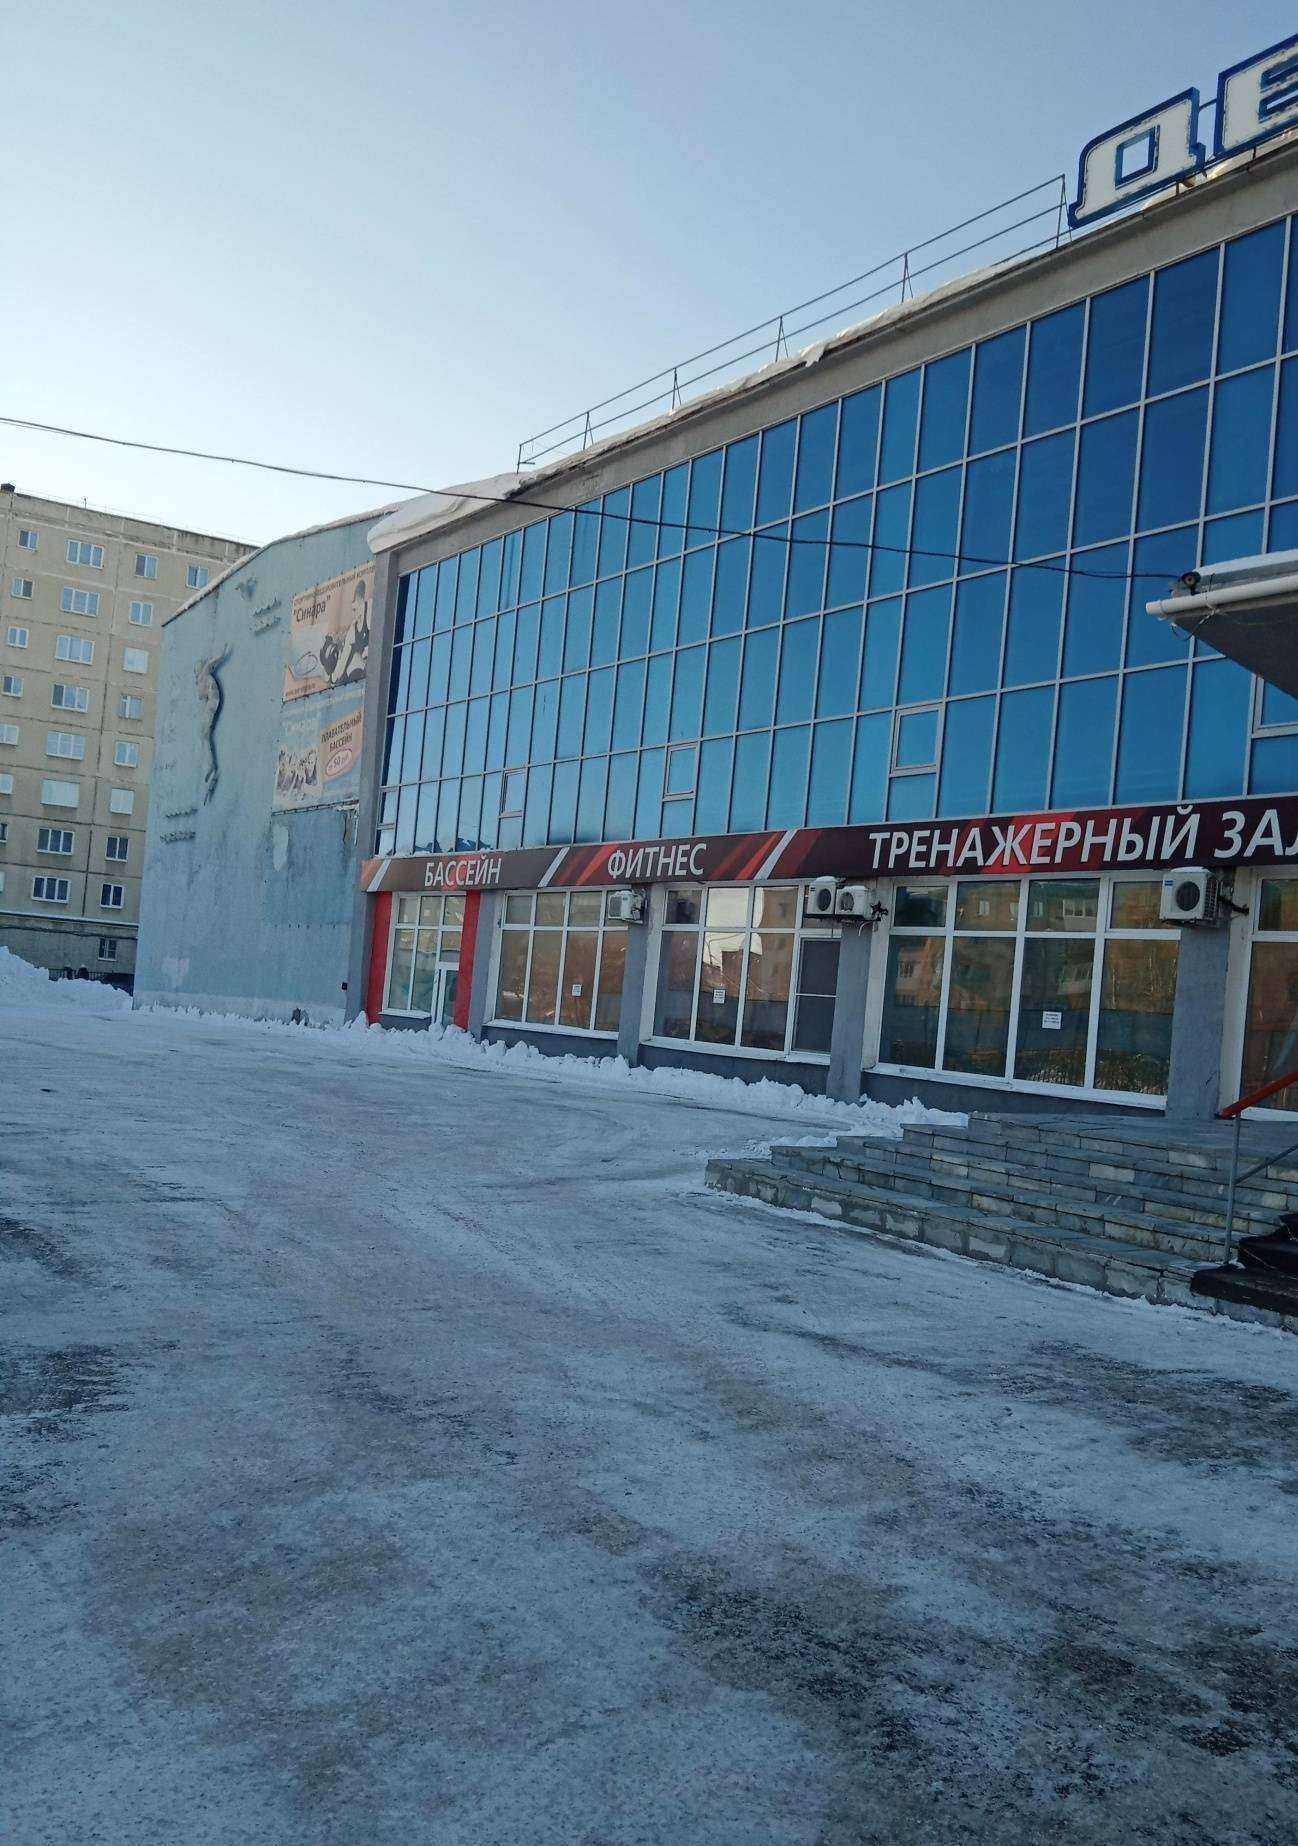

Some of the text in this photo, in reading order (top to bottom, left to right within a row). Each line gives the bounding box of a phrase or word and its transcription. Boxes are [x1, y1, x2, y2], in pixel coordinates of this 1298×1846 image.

[868, 805, 1201, 869] ТРЕНАЖЕРНЫЙ
[424, 857, 502, 888] БАССЕЙН
[607, 843, 707, 880] ФИТНЕС
